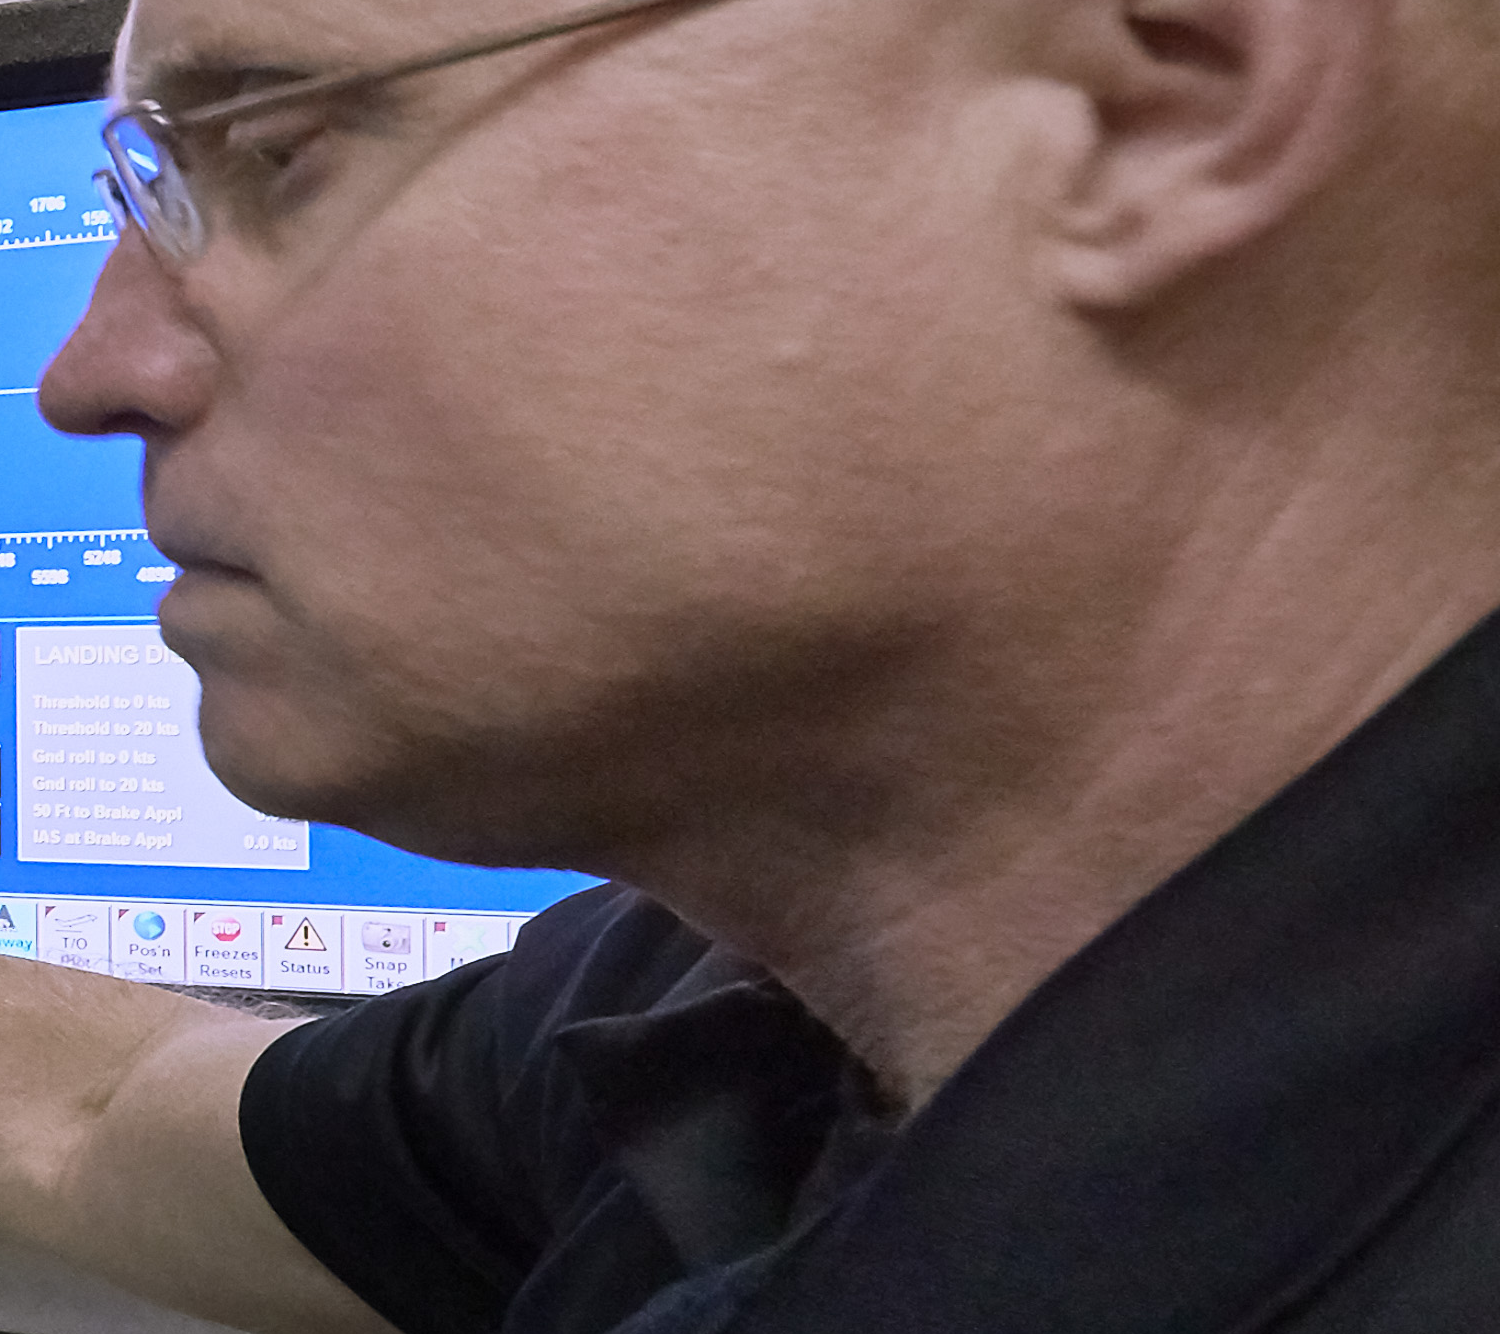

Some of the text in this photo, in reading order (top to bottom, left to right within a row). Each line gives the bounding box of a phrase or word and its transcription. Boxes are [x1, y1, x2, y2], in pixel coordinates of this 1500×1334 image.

[34, 644, 139, 665] LANDING
[194, 946, 258, 963] Freezes
[200, 965, 252, 980] Resets
[280, 960, 330, 976] Status
[364, 958, 407, 974] Snap
